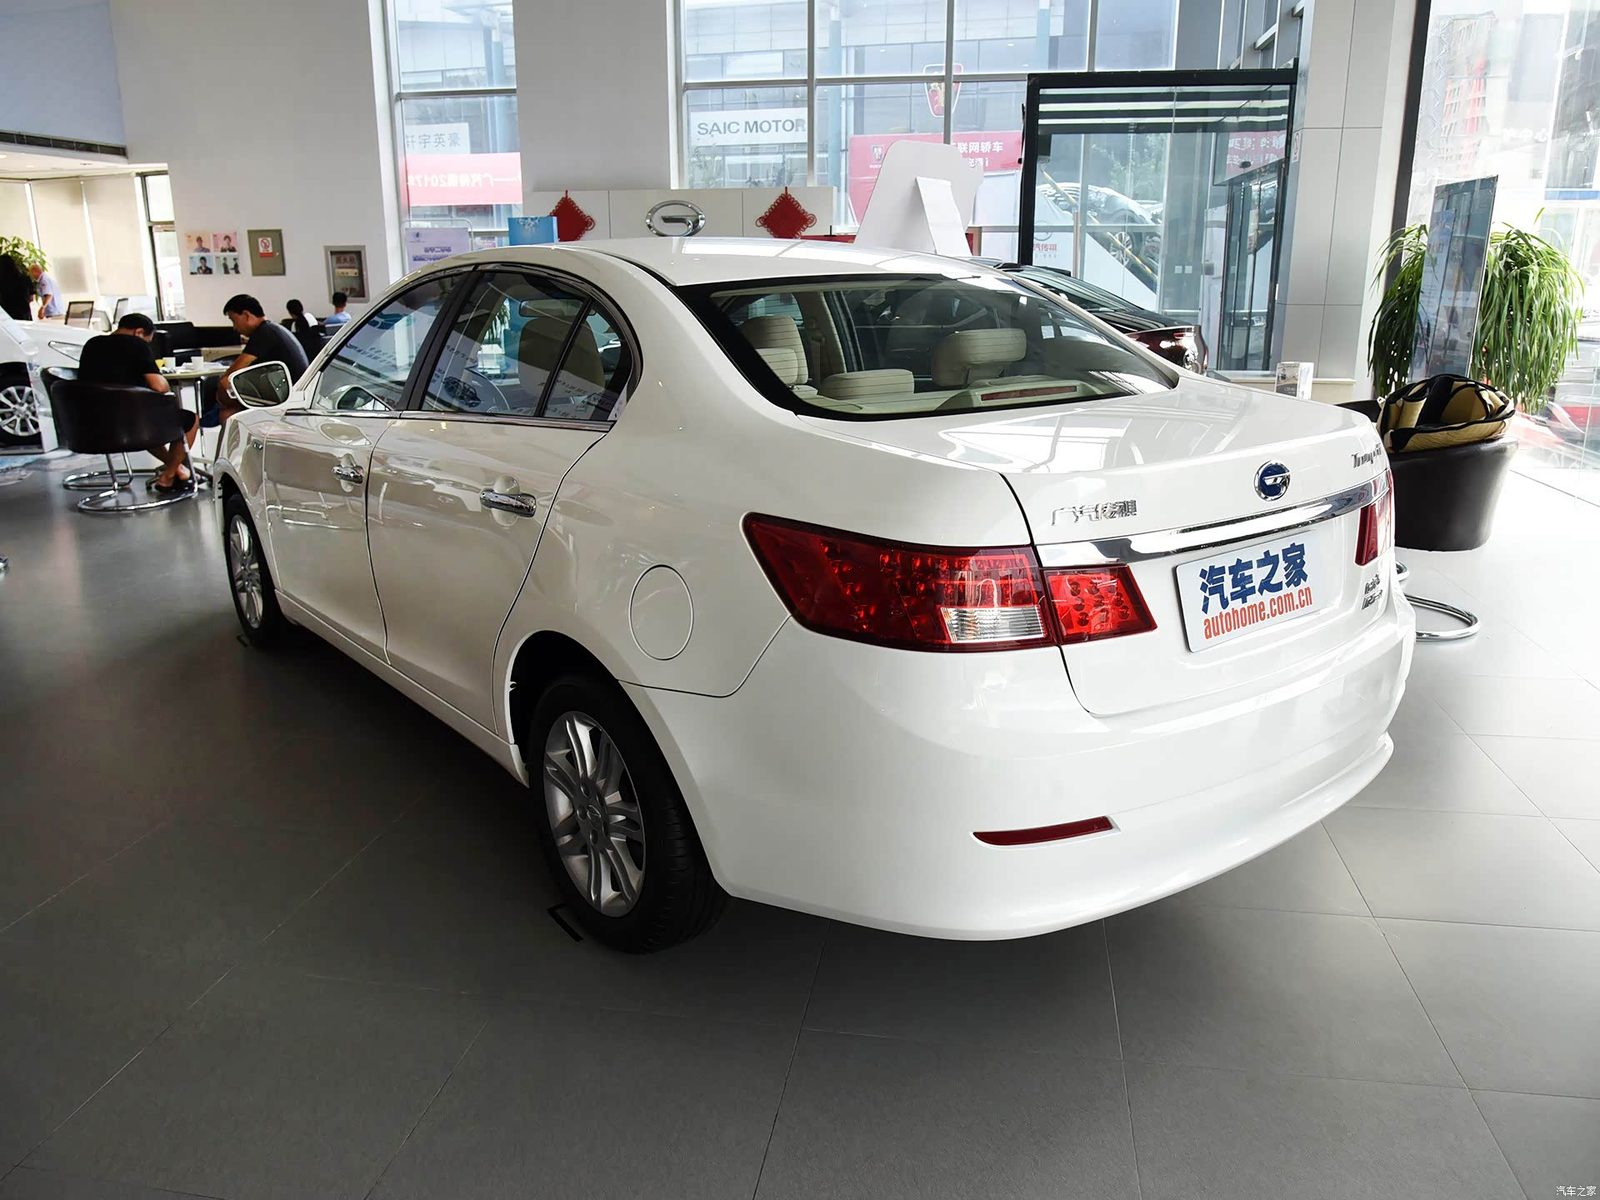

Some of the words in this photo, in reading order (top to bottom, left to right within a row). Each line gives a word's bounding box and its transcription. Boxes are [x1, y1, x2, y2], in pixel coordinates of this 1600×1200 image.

[697, 121, 740, 135] SAIC
[744, 119, 806, 133] MOTOR
[952, 141, 1004, 154] 联网轿车
[1051, 499, 1137, 526] 广汽传祺
[1198, 542, 1309, 615] 汽车之家
[1203, 586, 1313, 640] autohome.com.cn
